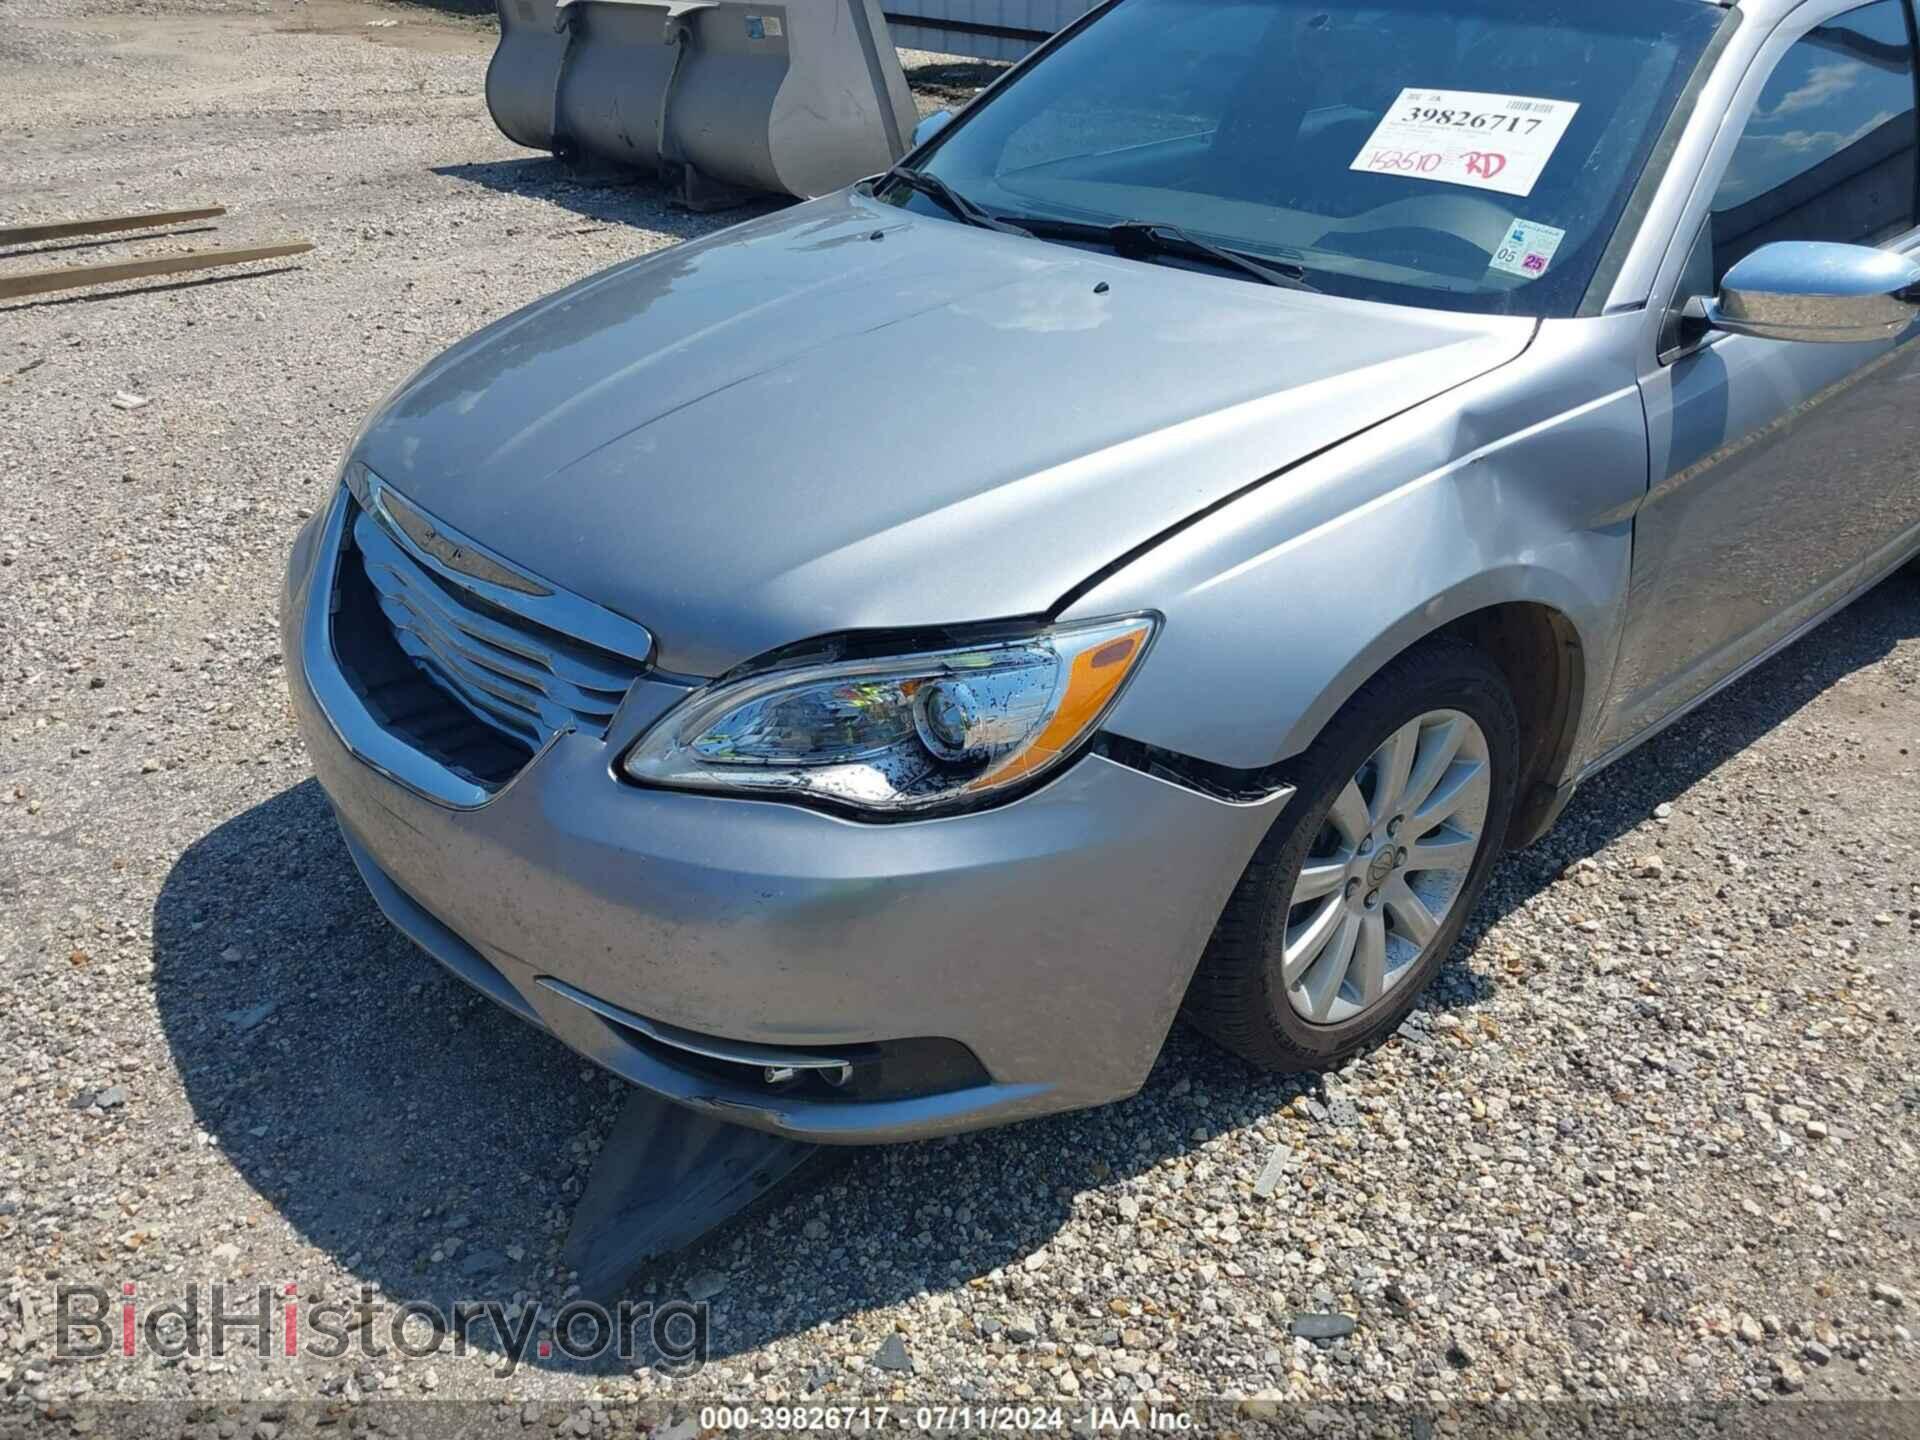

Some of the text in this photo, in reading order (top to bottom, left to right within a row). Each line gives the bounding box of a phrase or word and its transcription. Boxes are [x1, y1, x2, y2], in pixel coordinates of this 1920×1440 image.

[1401, 106, 1542, 136] 39826717
[1497, 248, 1517, 263] 05
[1523, 255, 1545, 270] 25
